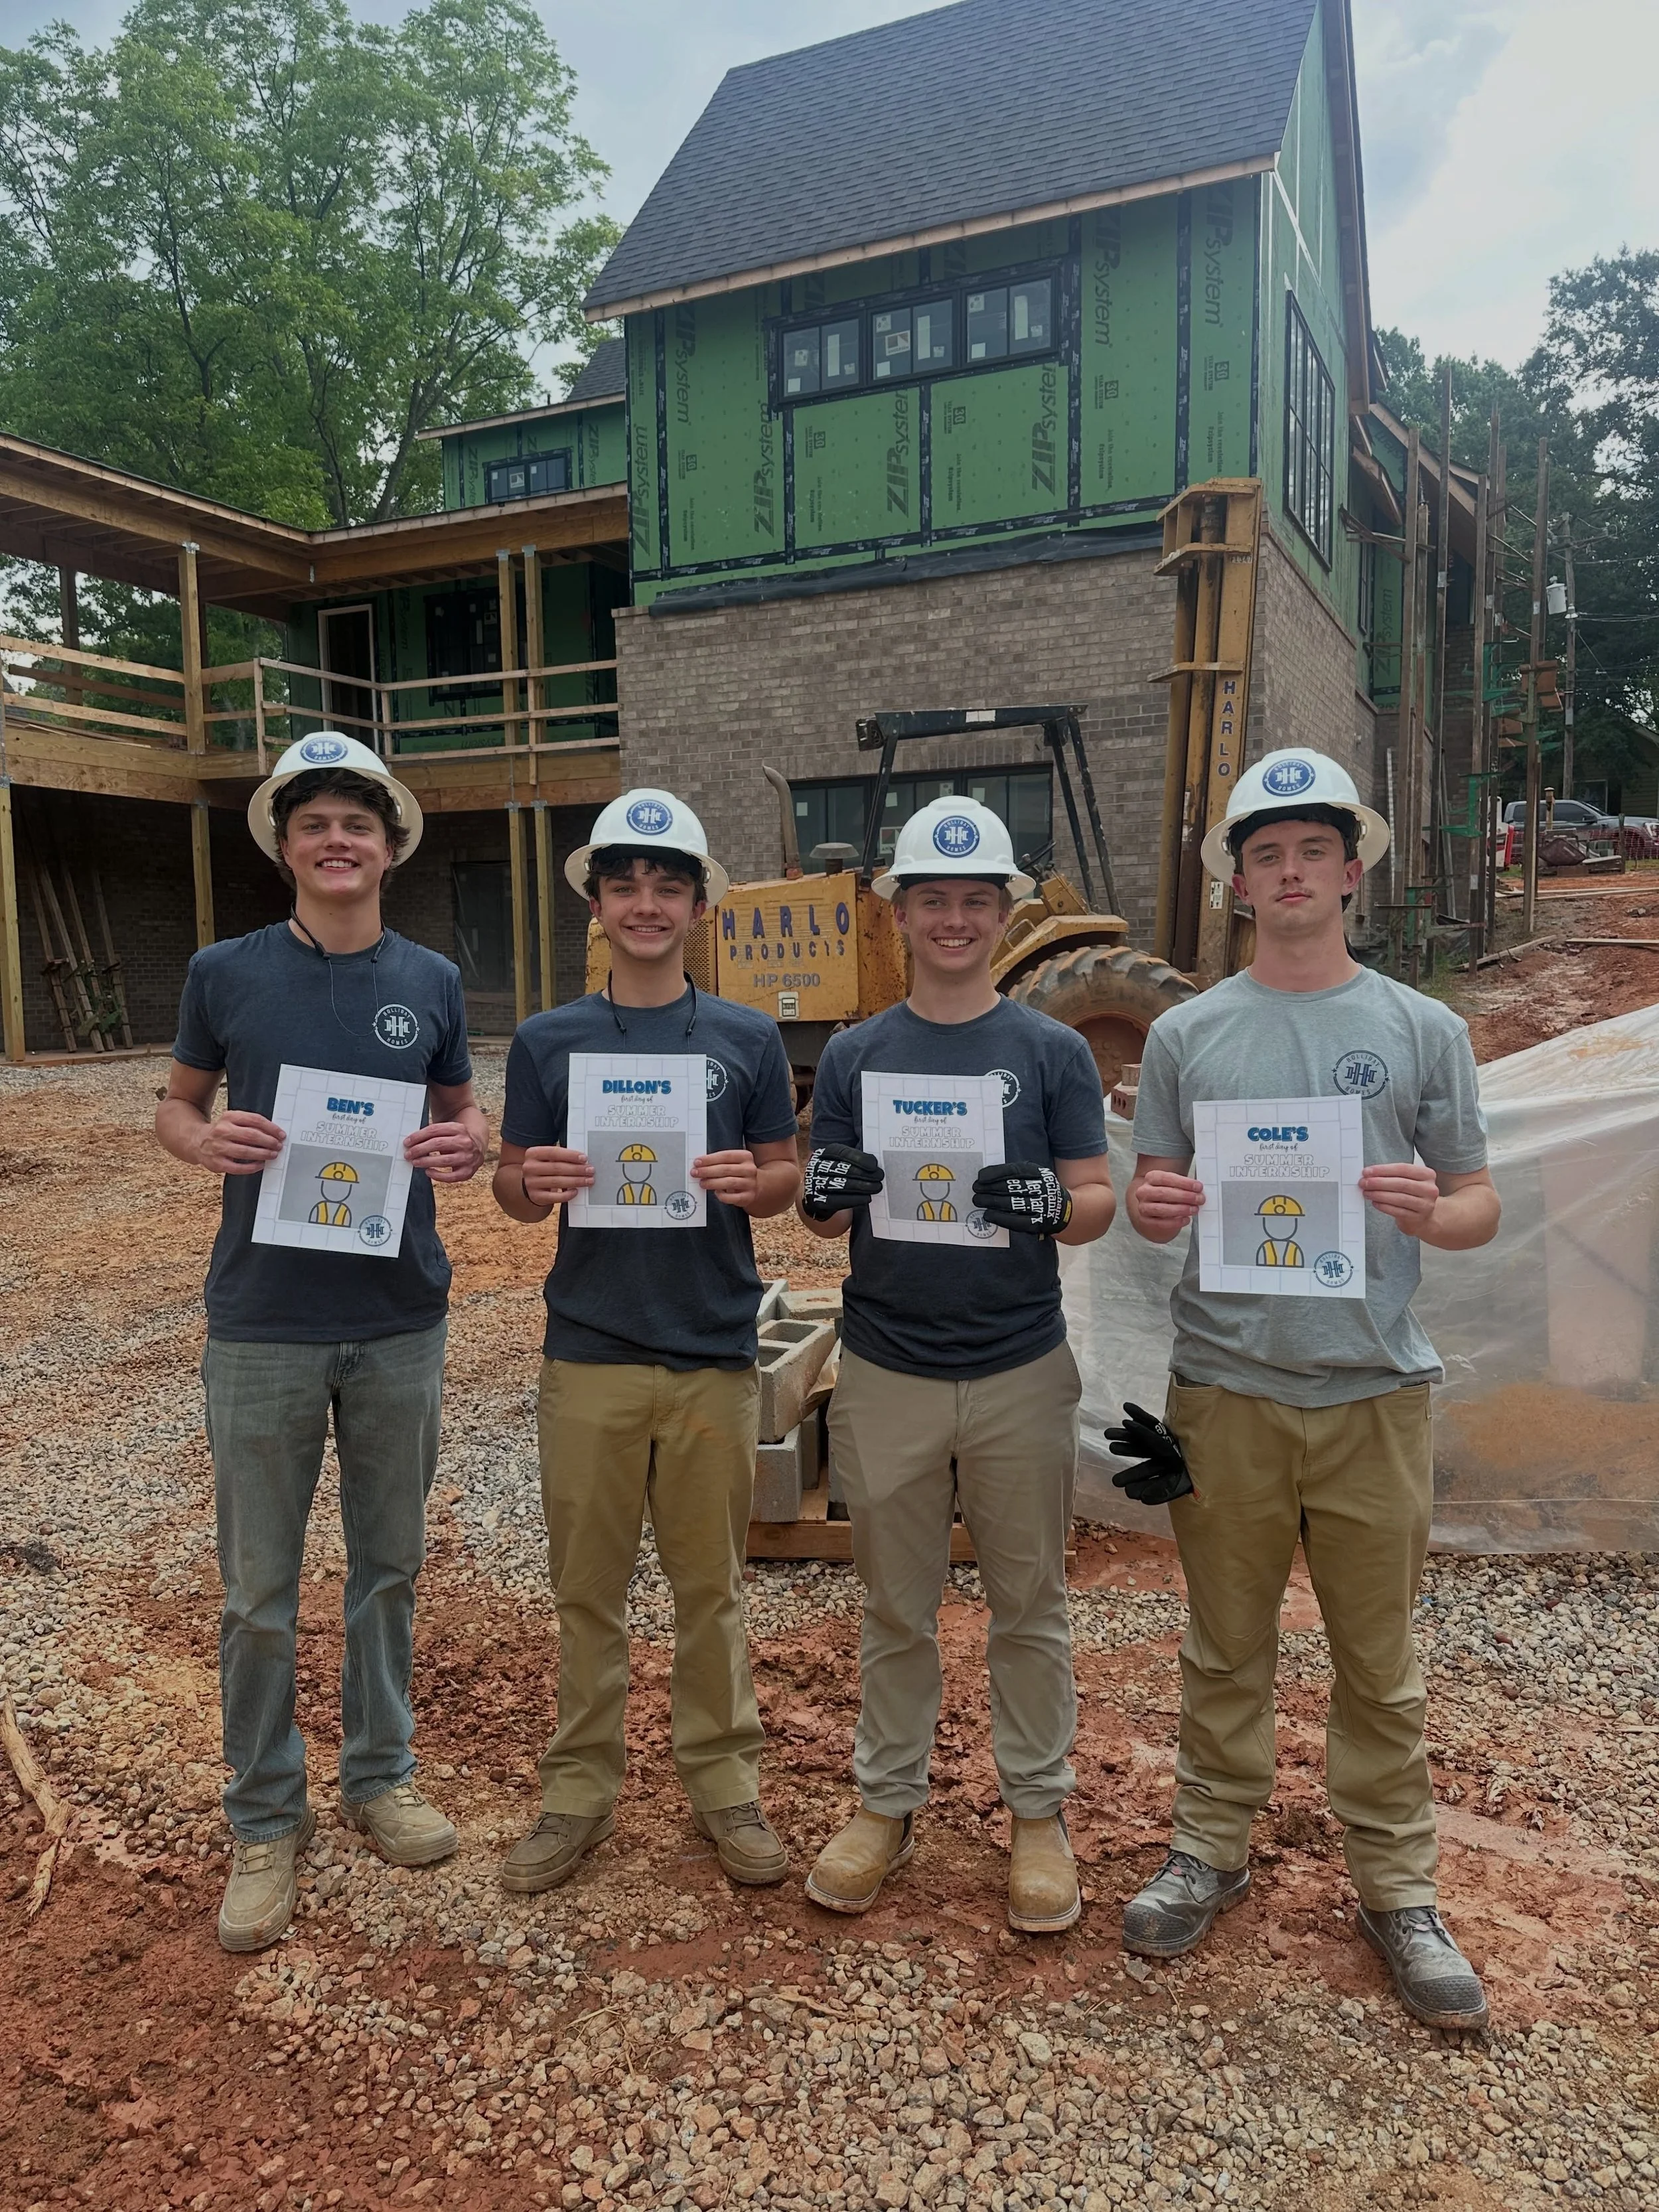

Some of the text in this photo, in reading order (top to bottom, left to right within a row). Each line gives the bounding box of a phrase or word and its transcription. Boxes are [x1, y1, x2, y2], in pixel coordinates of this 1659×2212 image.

[1218, 681, 1236, 776] HARLO
[721, 901, 850, 941] HARLO
[729, 938, 846, 961] PRODUCTS
[753, 972, 820, 988] HP 6500
[382, 1008, 411, 1018] HOLLIDAY
[1346, 1054, 1381, 1067] HOLLIDAY
[603, 1080, 672, 1095] DILLON'S
[1344, 1086, 1371, 1096] HOMES
[326, 1097, 374, 1116] BEN'S
[608, 1104, 666, 1116] SUMMER
[893, 1100, 968, 1116] TUCKER'S
[595, 1116, 679, 1128] INTERNSHIP
[317, 1121, 377, 1139] SUMMER
[902, 1126, 961, 1138] SUMMER
[1248, 1126, 1309, 1142] COLE'S
[300, 1130, 388, 1151] INTERNSHIP
[889, 1137, 975, 1148] INTERNSHIP
[1244, 1153, 1314, 1165] SUMMER
[1230, 1165, 1330, 1177] INTERNSHIP
[1039, 1167, 1058, 1218] Mechanix
